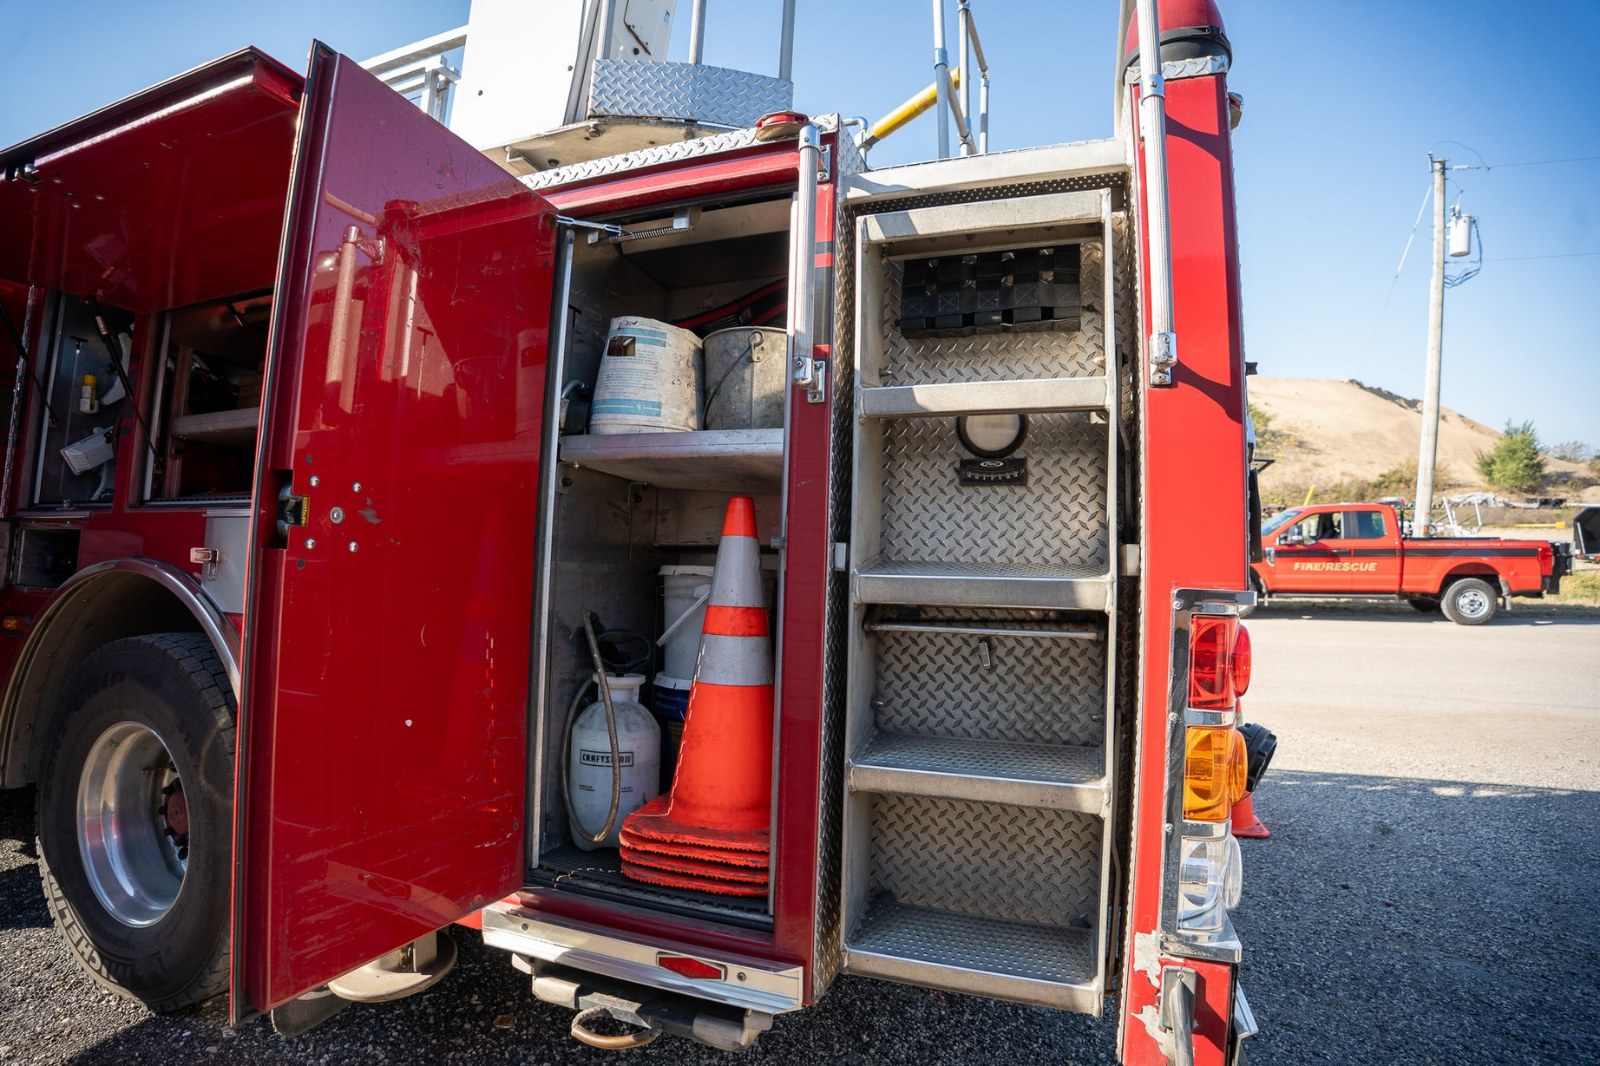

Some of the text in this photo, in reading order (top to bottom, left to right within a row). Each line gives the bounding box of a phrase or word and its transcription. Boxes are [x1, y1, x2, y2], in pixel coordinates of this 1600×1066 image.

[1293, 562, 1377, 571] FIRE/RESCUE
[582, 753, 630, 764] CRAFTSAN
[47, 868, 133, 986] MICHELIN
